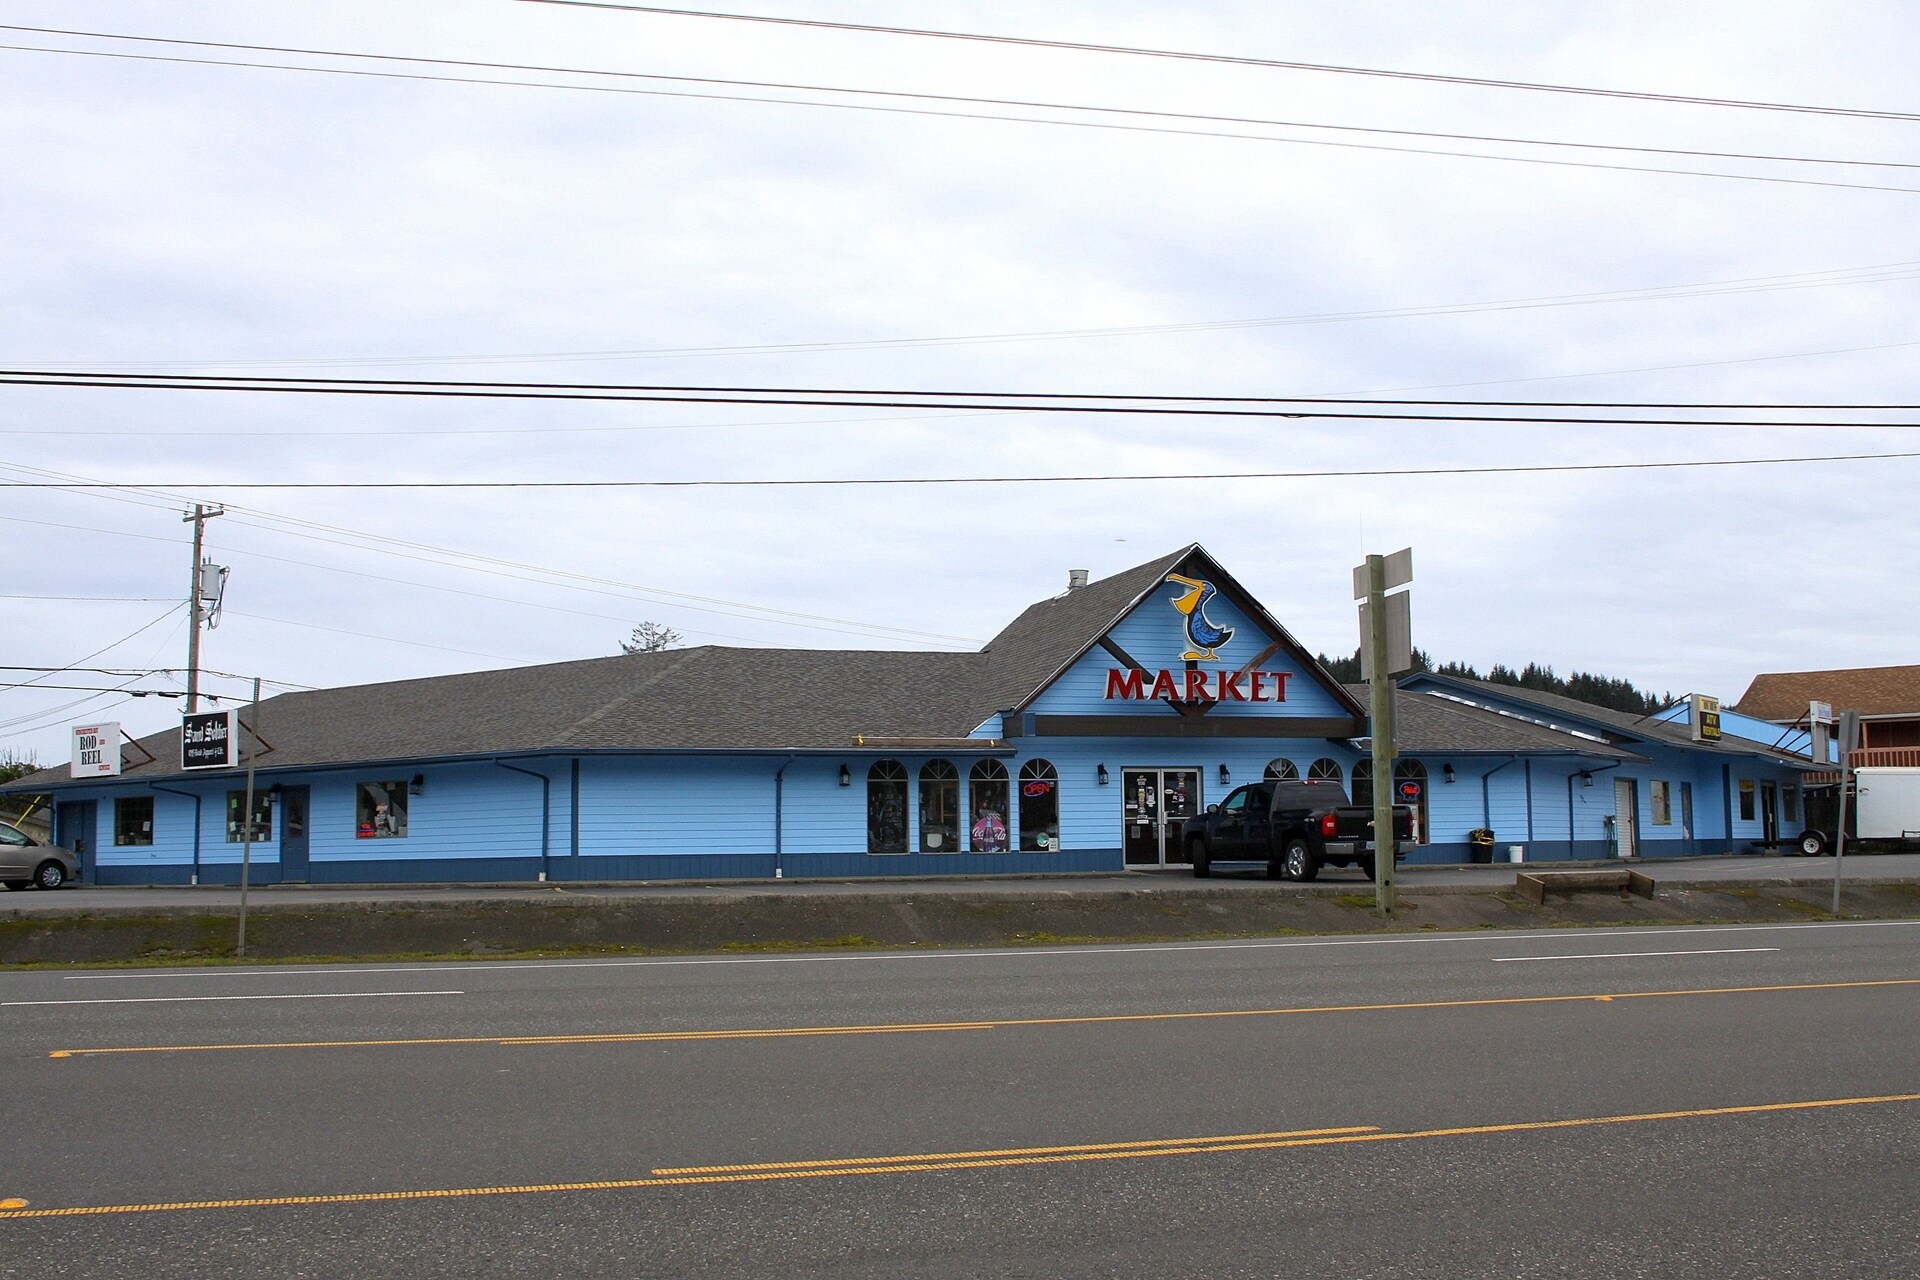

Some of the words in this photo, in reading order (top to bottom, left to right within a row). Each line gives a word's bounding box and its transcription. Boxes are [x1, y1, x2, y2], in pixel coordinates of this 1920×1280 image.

[1104, 668, 1293, 703] MARKET
[184, 721, 204, 744] Sand
[204, 719, 228, 742] Soldier
[79, 735, 97, 750] ROD
[81, 750, 103, 765] REEL
[1024, 783, 1050, 794] OPEN
